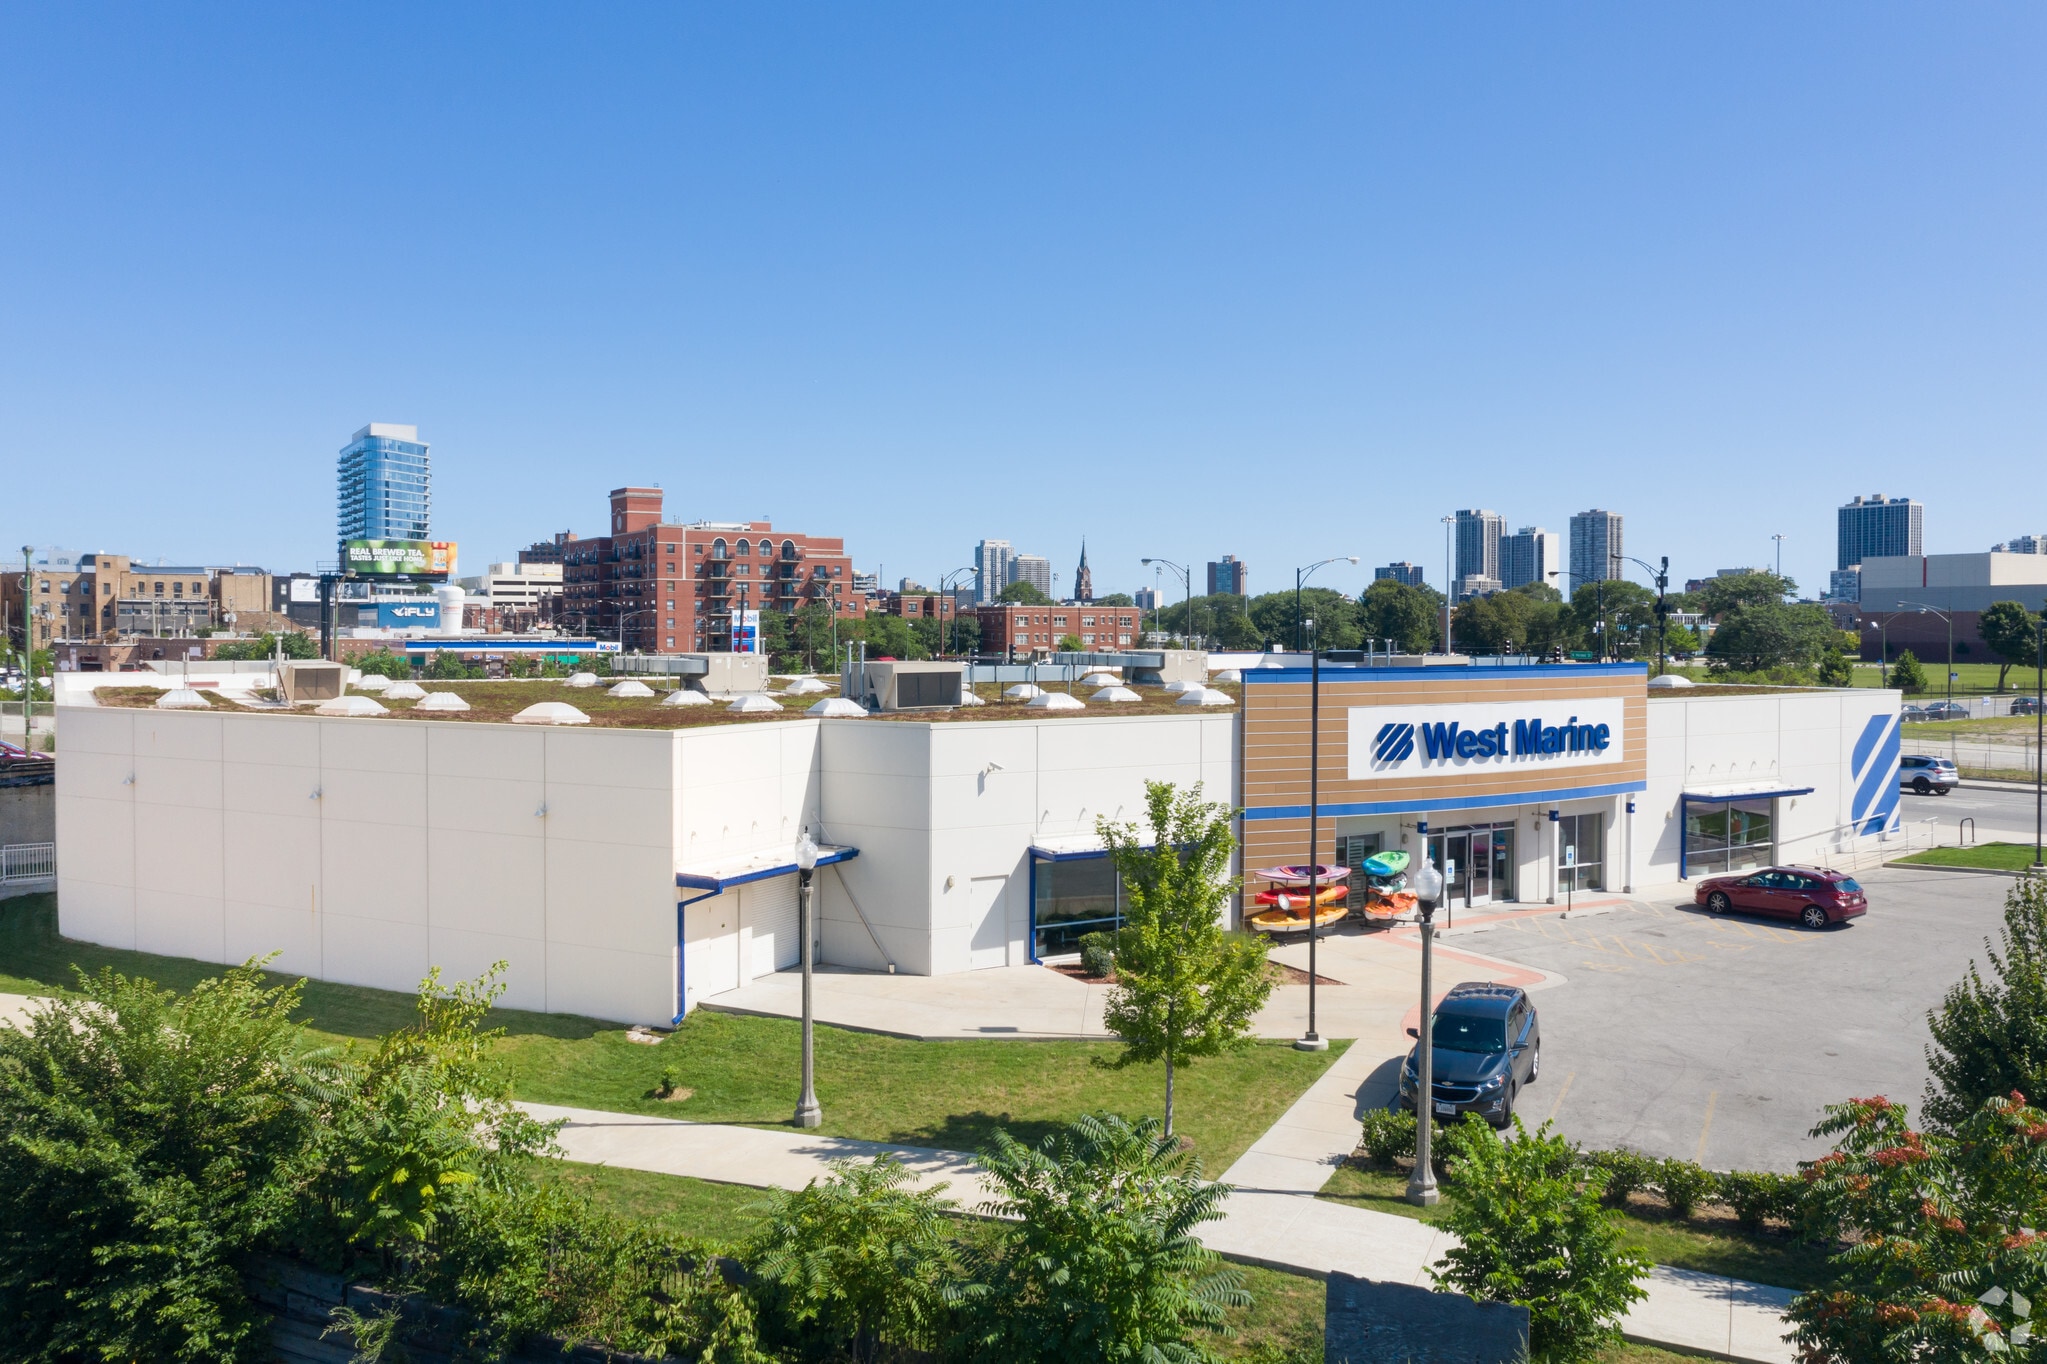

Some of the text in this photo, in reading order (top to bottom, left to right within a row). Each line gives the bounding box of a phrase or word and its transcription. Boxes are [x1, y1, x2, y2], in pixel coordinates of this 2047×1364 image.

[373, 548, 406, 556] BREWED
[404, 607, 434, 617] iFLY
[734, 614, 757, 622] Mobil
[1422, 716, 1610, 759] West Marine
